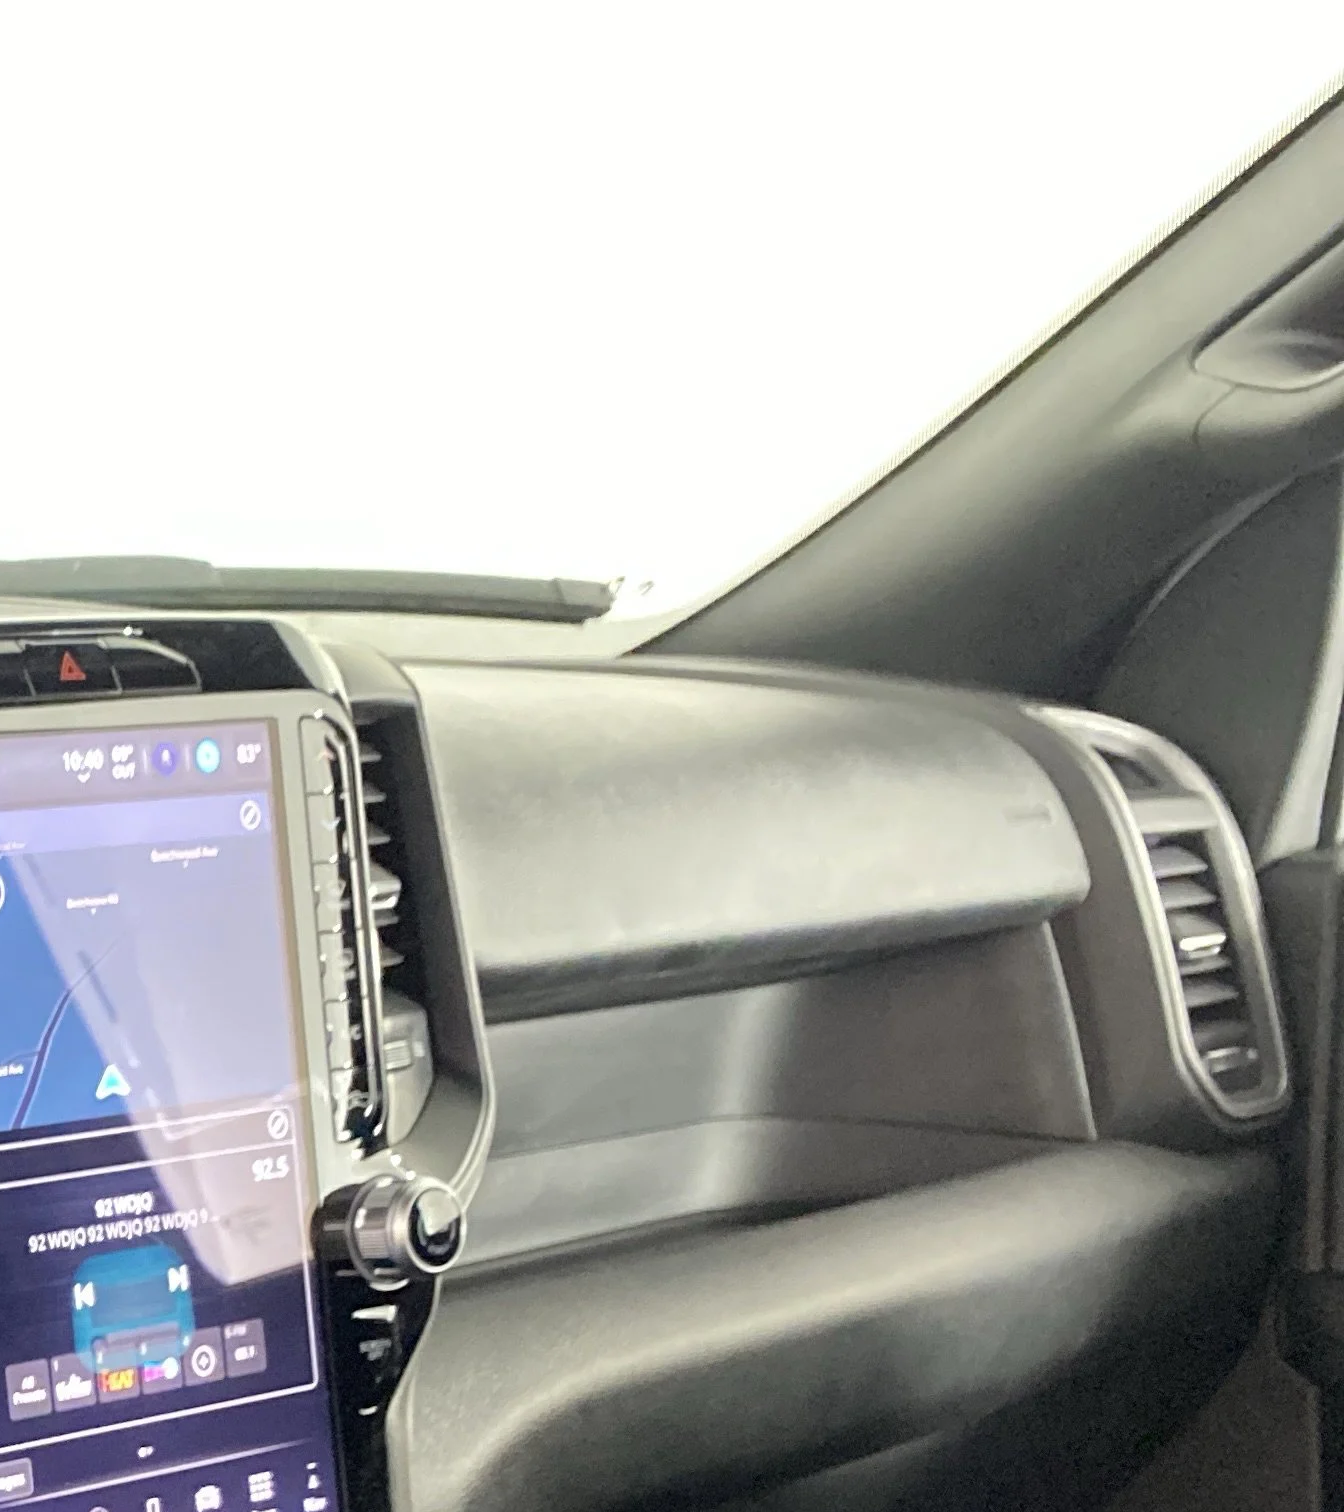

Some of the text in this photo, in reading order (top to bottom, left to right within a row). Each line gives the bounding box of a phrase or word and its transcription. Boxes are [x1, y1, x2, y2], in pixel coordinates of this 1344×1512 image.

[95, 1199, 112, 1218] 92
[28, 1235, 46, 1253] 92
[47, 1227, 87, 1250] WDJQ
[88, 1227, 104, 1243] 92
[105, 1219, 143, 1240] WDJQ
[144, 1216, 161, 1232] 92
